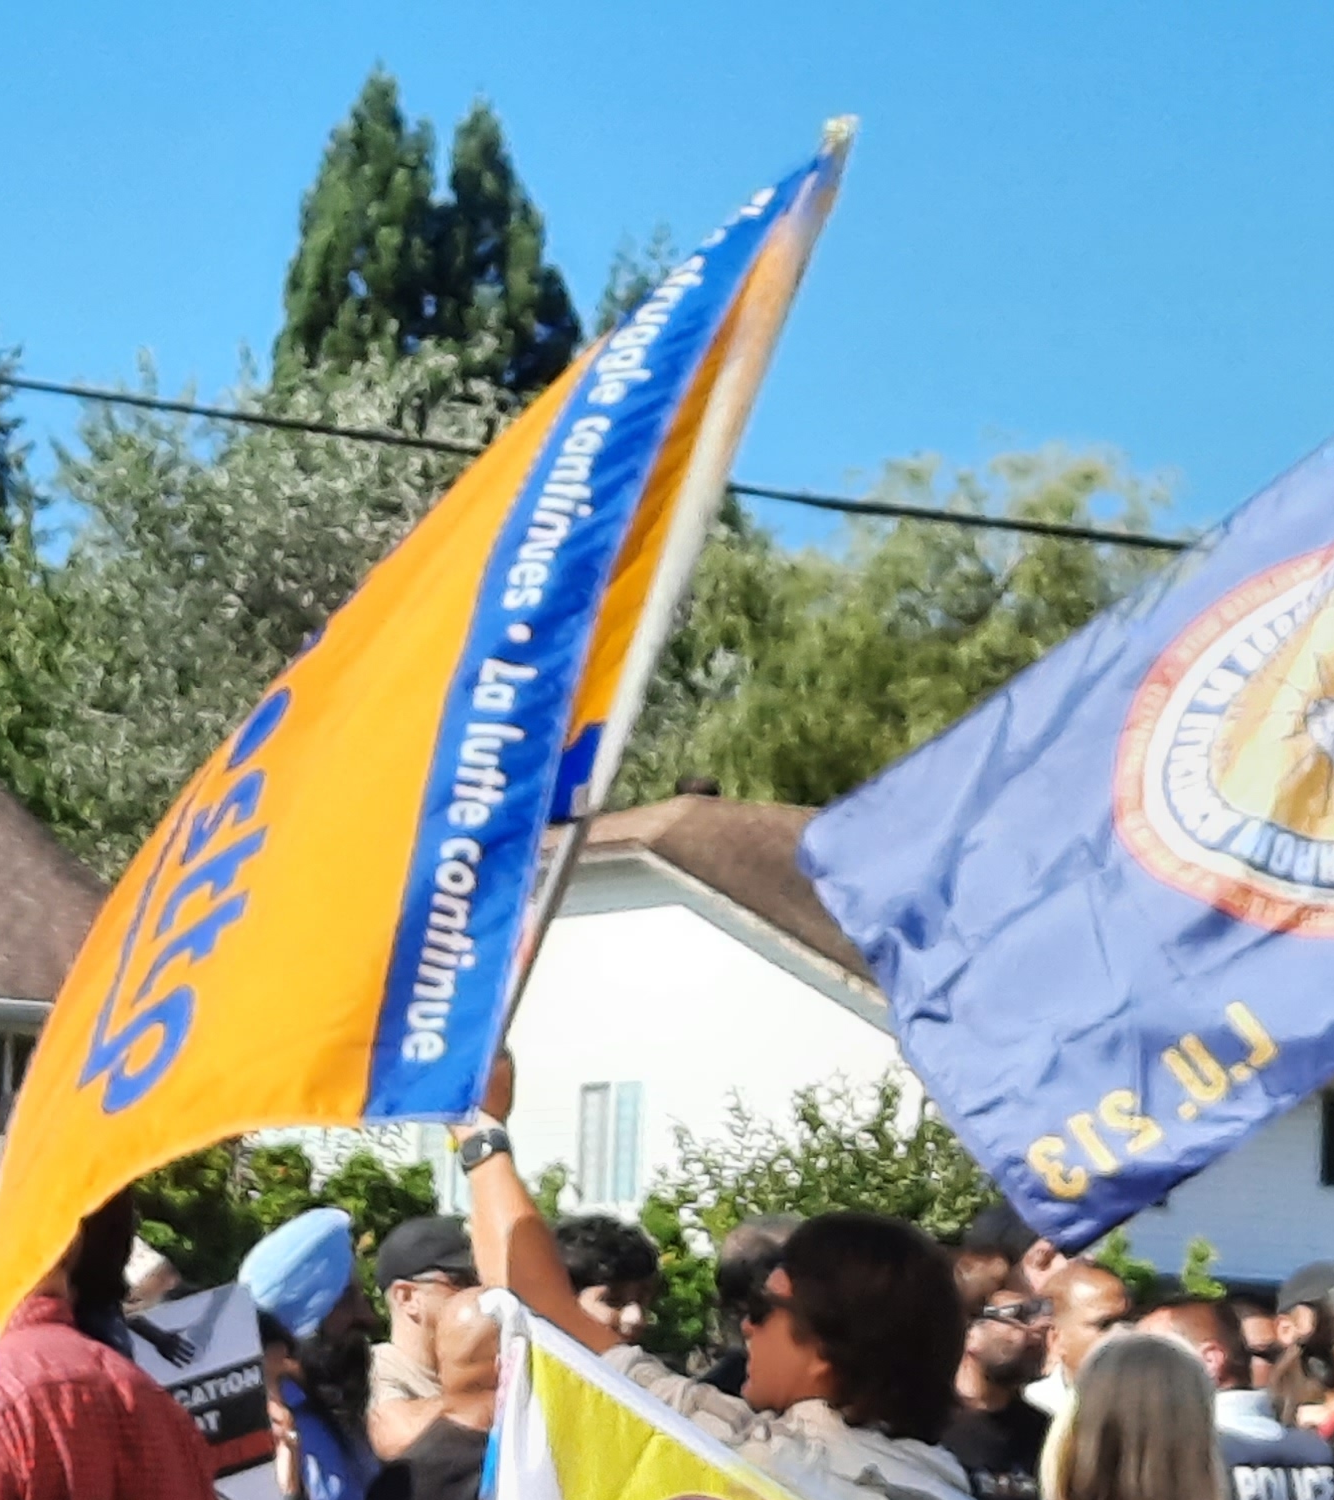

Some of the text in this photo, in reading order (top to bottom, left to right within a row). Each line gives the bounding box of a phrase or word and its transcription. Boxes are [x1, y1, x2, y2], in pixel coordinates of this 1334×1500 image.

[400, 254, 706, 1063] struggle continues La lutte continue
